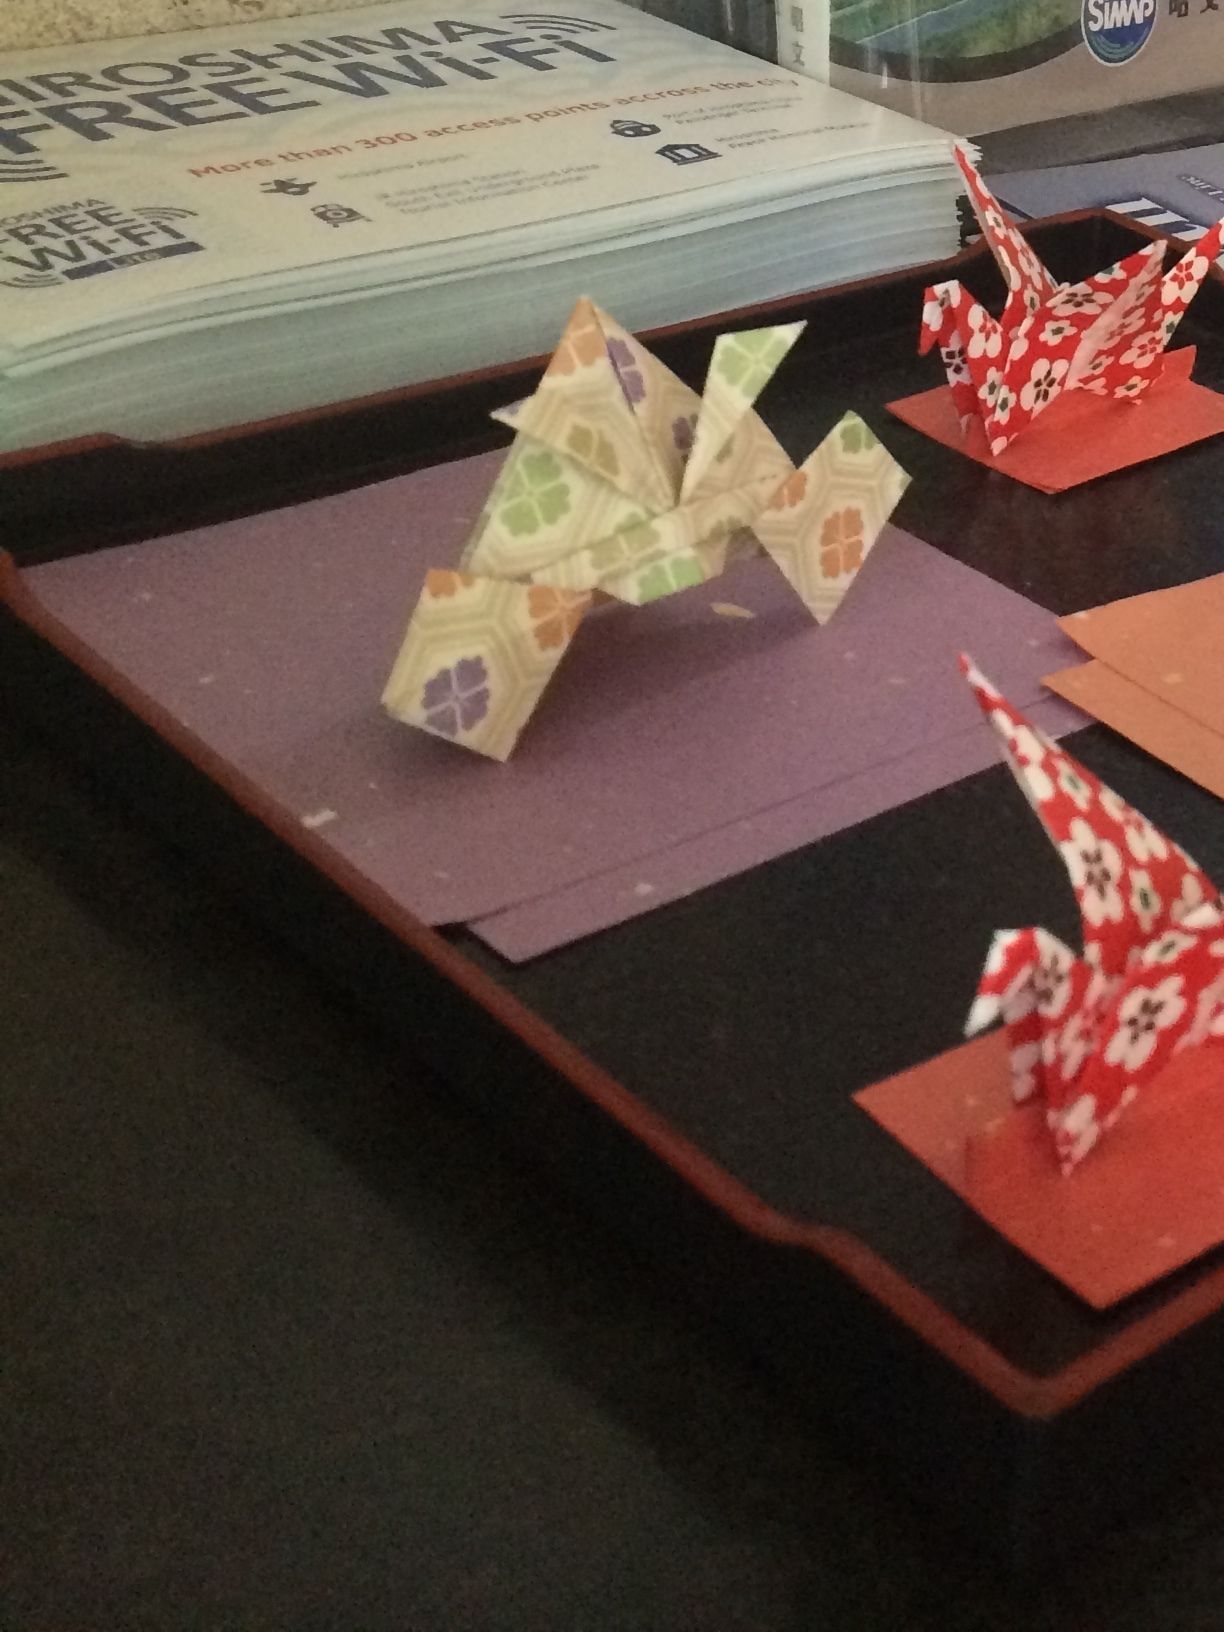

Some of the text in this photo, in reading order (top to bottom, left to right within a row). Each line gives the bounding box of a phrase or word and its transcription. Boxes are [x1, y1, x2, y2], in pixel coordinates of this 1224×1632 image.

[0, 32, 618, 155] FREE Wi-Fi
[186, 157, 275, 179] More
[277, 143, 354, 164] than
[354, 131, 418, 151] 300
[423, 117, 516, 138] access
[524, 99, 610, 124] points
[615, 83, 707, 106] accross
[710, 76, 753, 92] the
[2, 220, 187, 272] Wi-Fi
